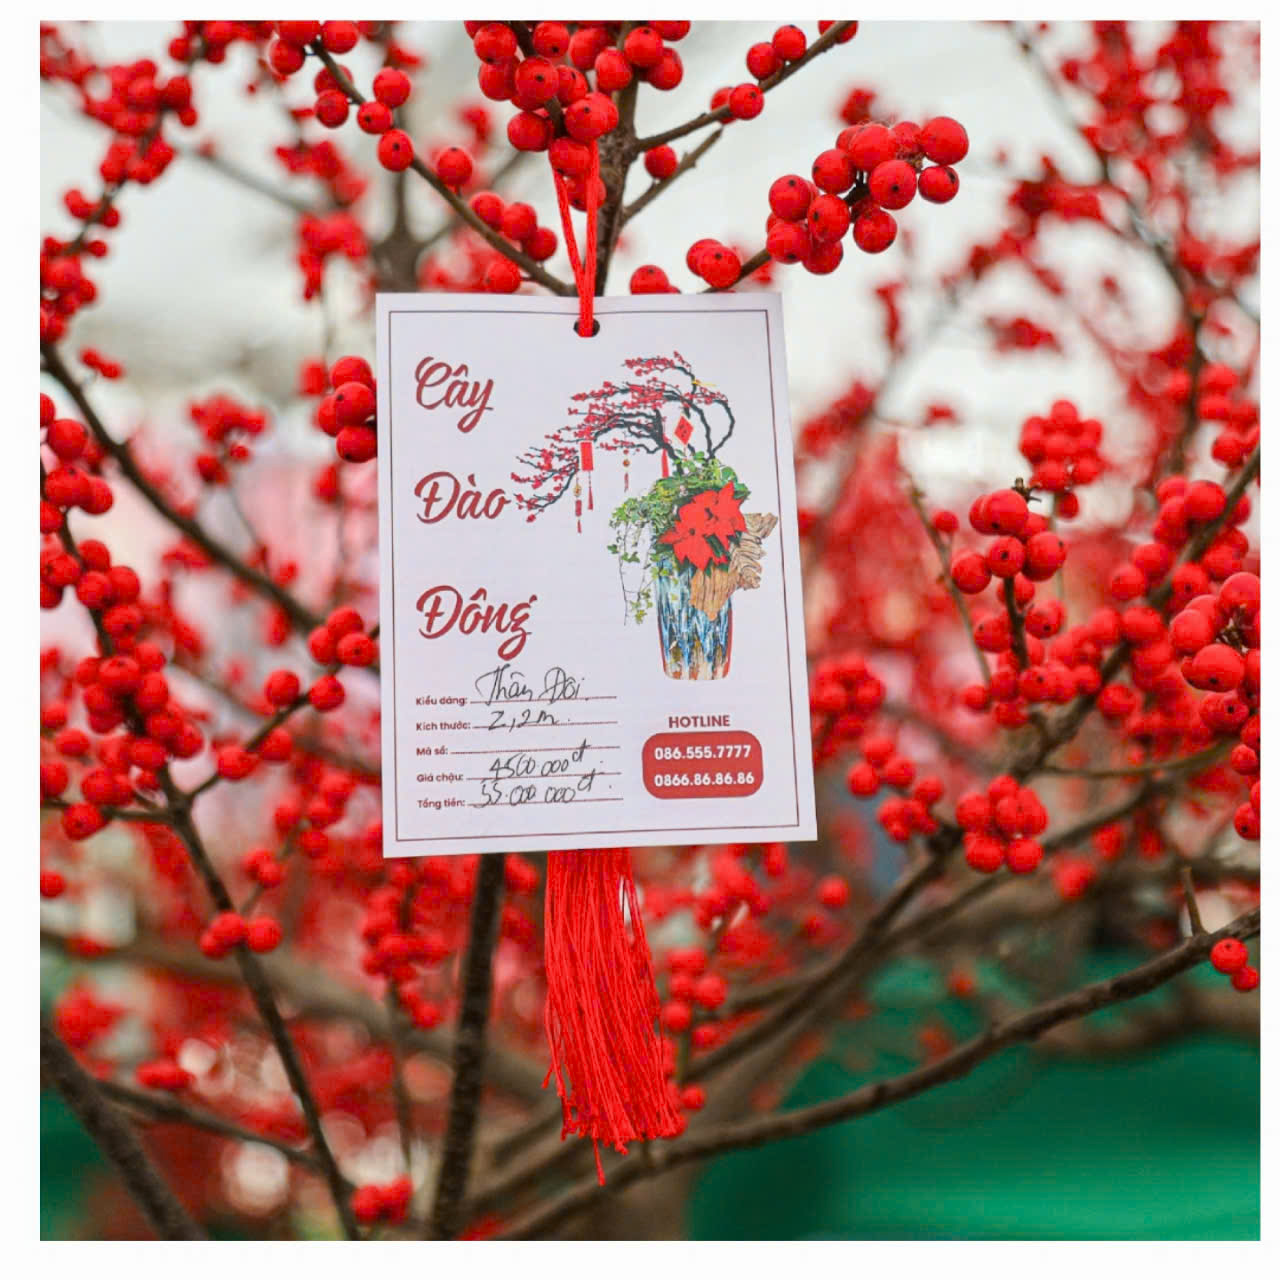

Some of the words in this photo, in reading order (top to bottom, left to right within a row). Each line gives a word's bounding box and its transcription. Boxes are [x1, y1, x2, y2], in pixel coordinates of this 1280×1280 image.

[414, 356, 494, 433] Cây
[413, 471, 512, 524] Đào
[415, 585, 538, 661] Đông
[415, 694, 438, 706] Kiểu
[415, 721, 438, 732] Kích
[668, 714, 731, 729] HOTLINE
[654, 744, 752, 761] 086.555.7777
[416, 773, 434, 783] Giá
[653, 771, 756, 788] 0866.86.86.86
[417, 797, 442, 811] Tổng
